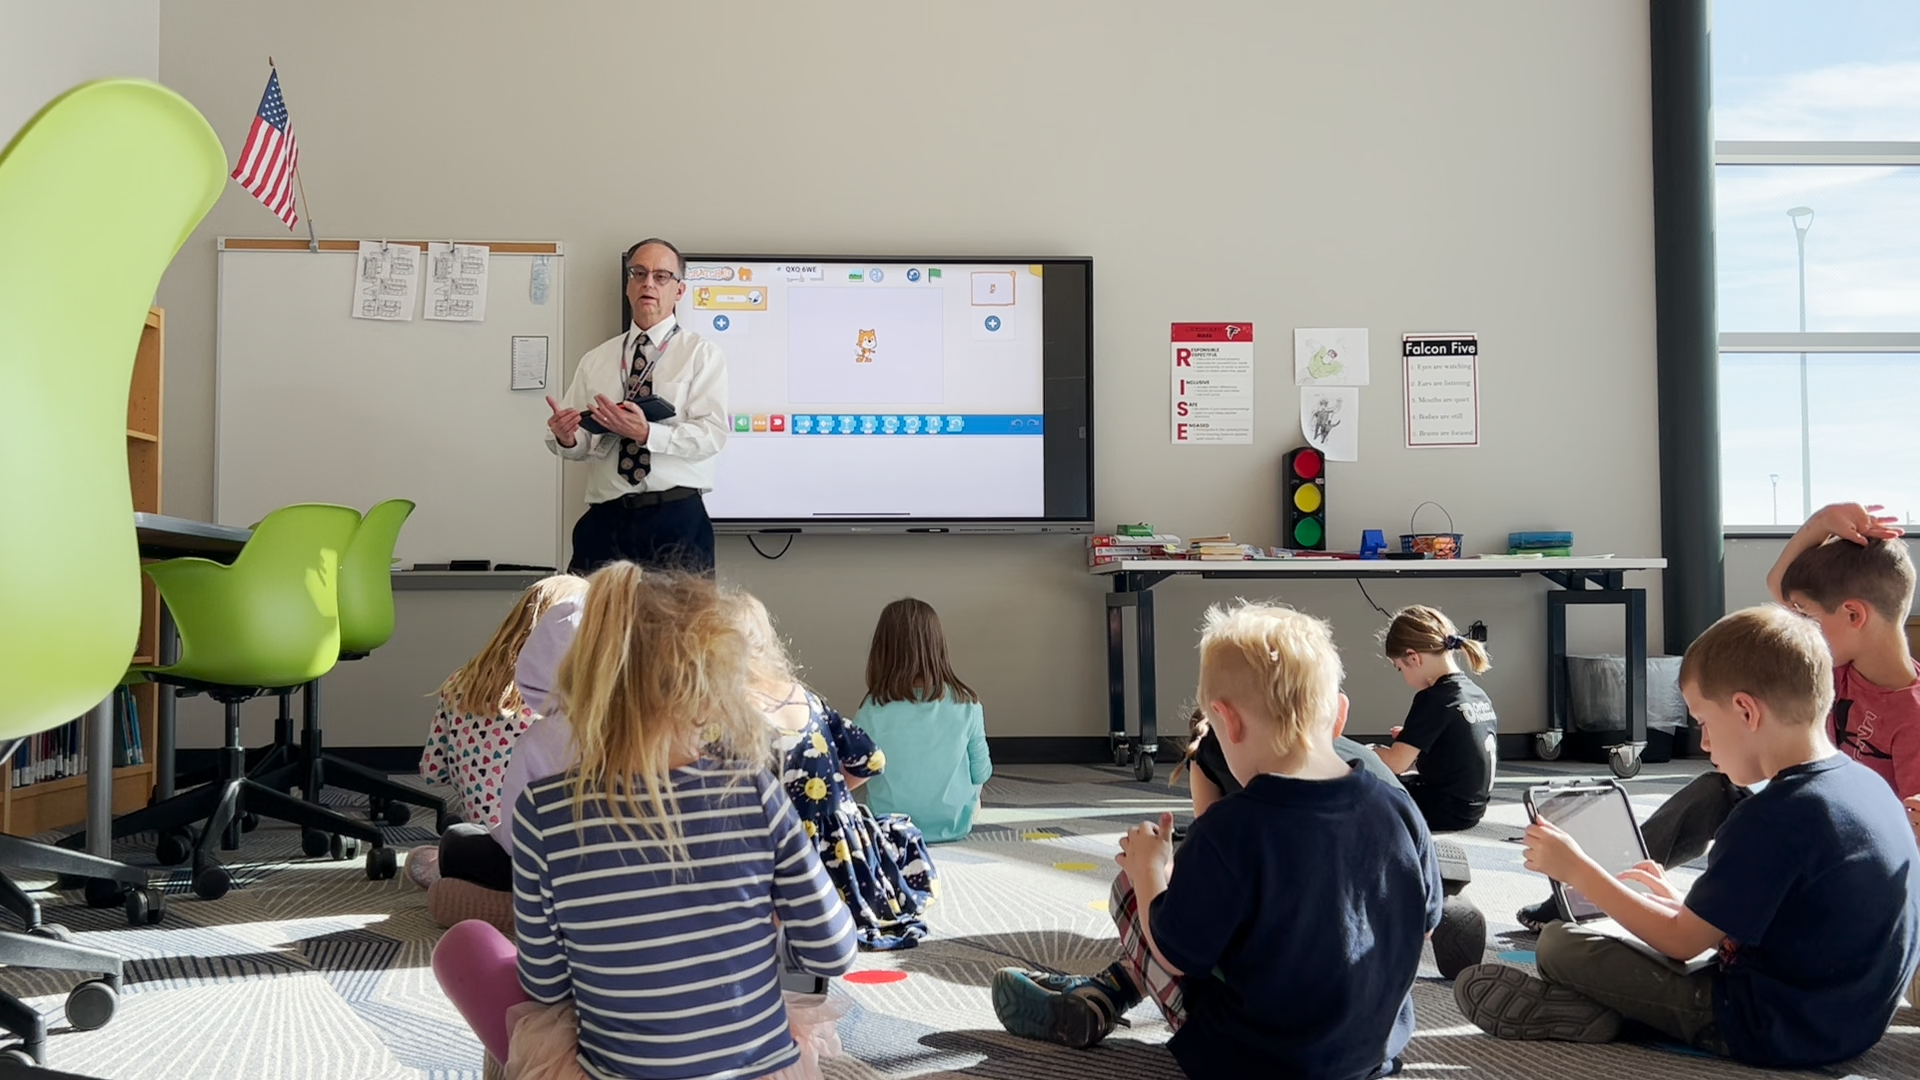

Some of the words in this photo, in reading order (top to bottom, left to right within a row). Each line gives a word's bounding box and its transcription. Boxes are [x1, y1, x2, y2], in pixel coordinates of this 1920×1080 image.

[1405, 341, 1447, 355] Falcon
[1451, 341, 1476, 354] Five
[1417, 363, 1432, 372] Eyes
[1444, 379, 1471, 387] listening
[1472, 701, 1491, 713] Ortho
